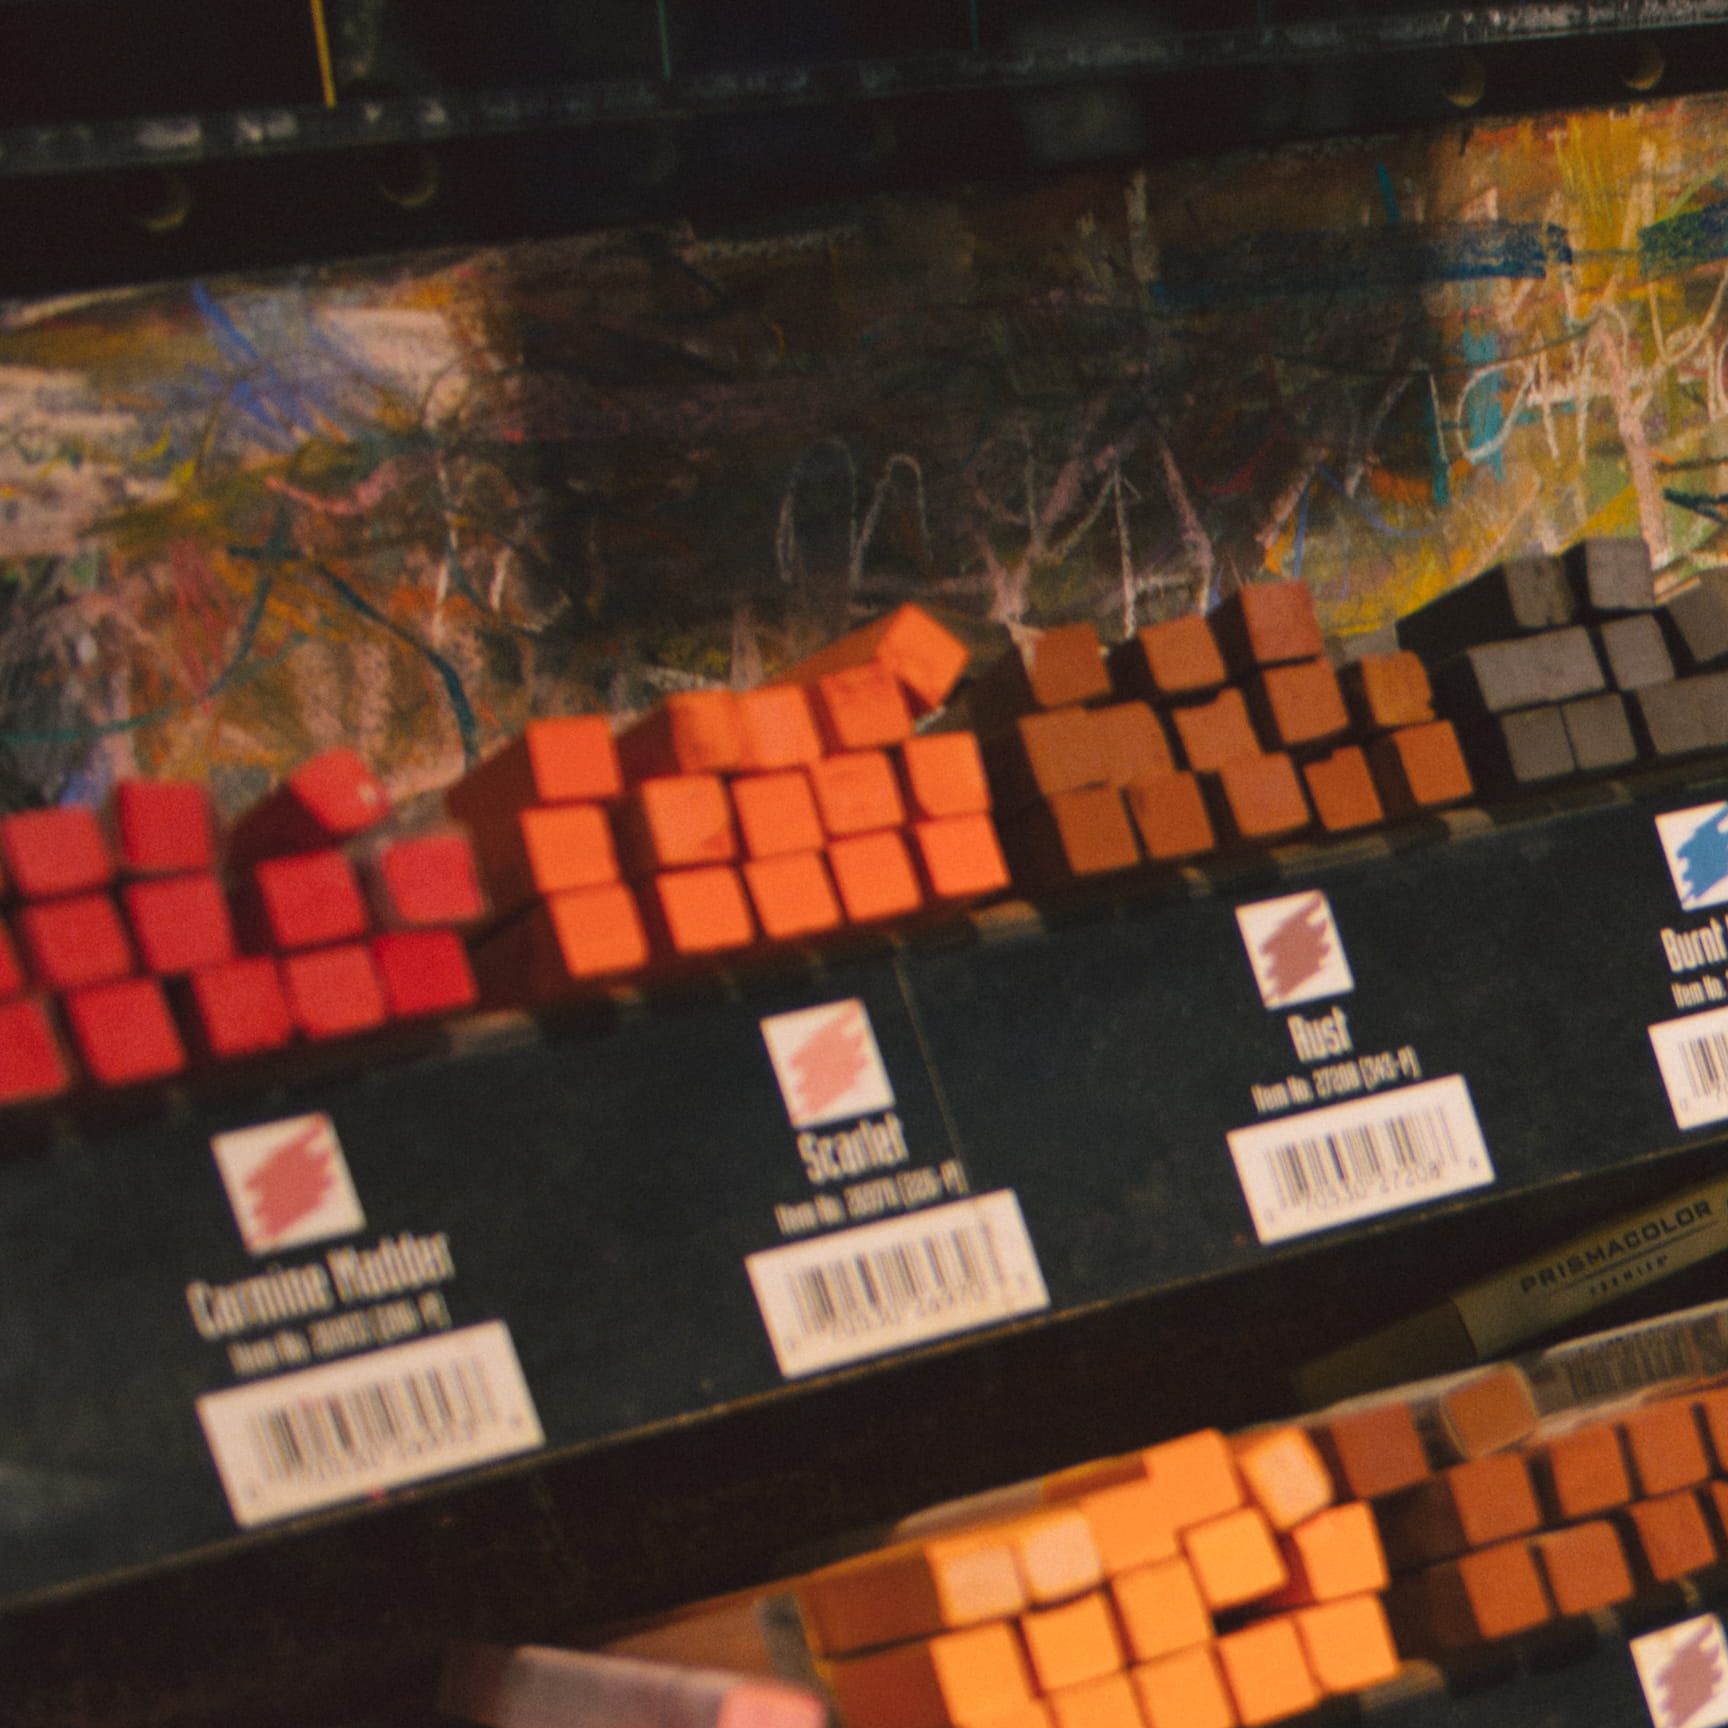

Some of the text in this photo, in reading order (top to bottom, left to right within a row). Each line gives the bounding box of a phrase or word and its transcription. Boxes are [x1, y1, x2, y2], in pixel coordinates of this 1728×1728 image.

[1661, 918, 1727, 972] Burnt
[1672, 982, 1704, 1007] Item
[1288, 1007, 1351, 1061] Rust
[798, 1114, 907, 1183] Scarlet
[1520, 1200, 1714, 1294] PRISMACOLOR
